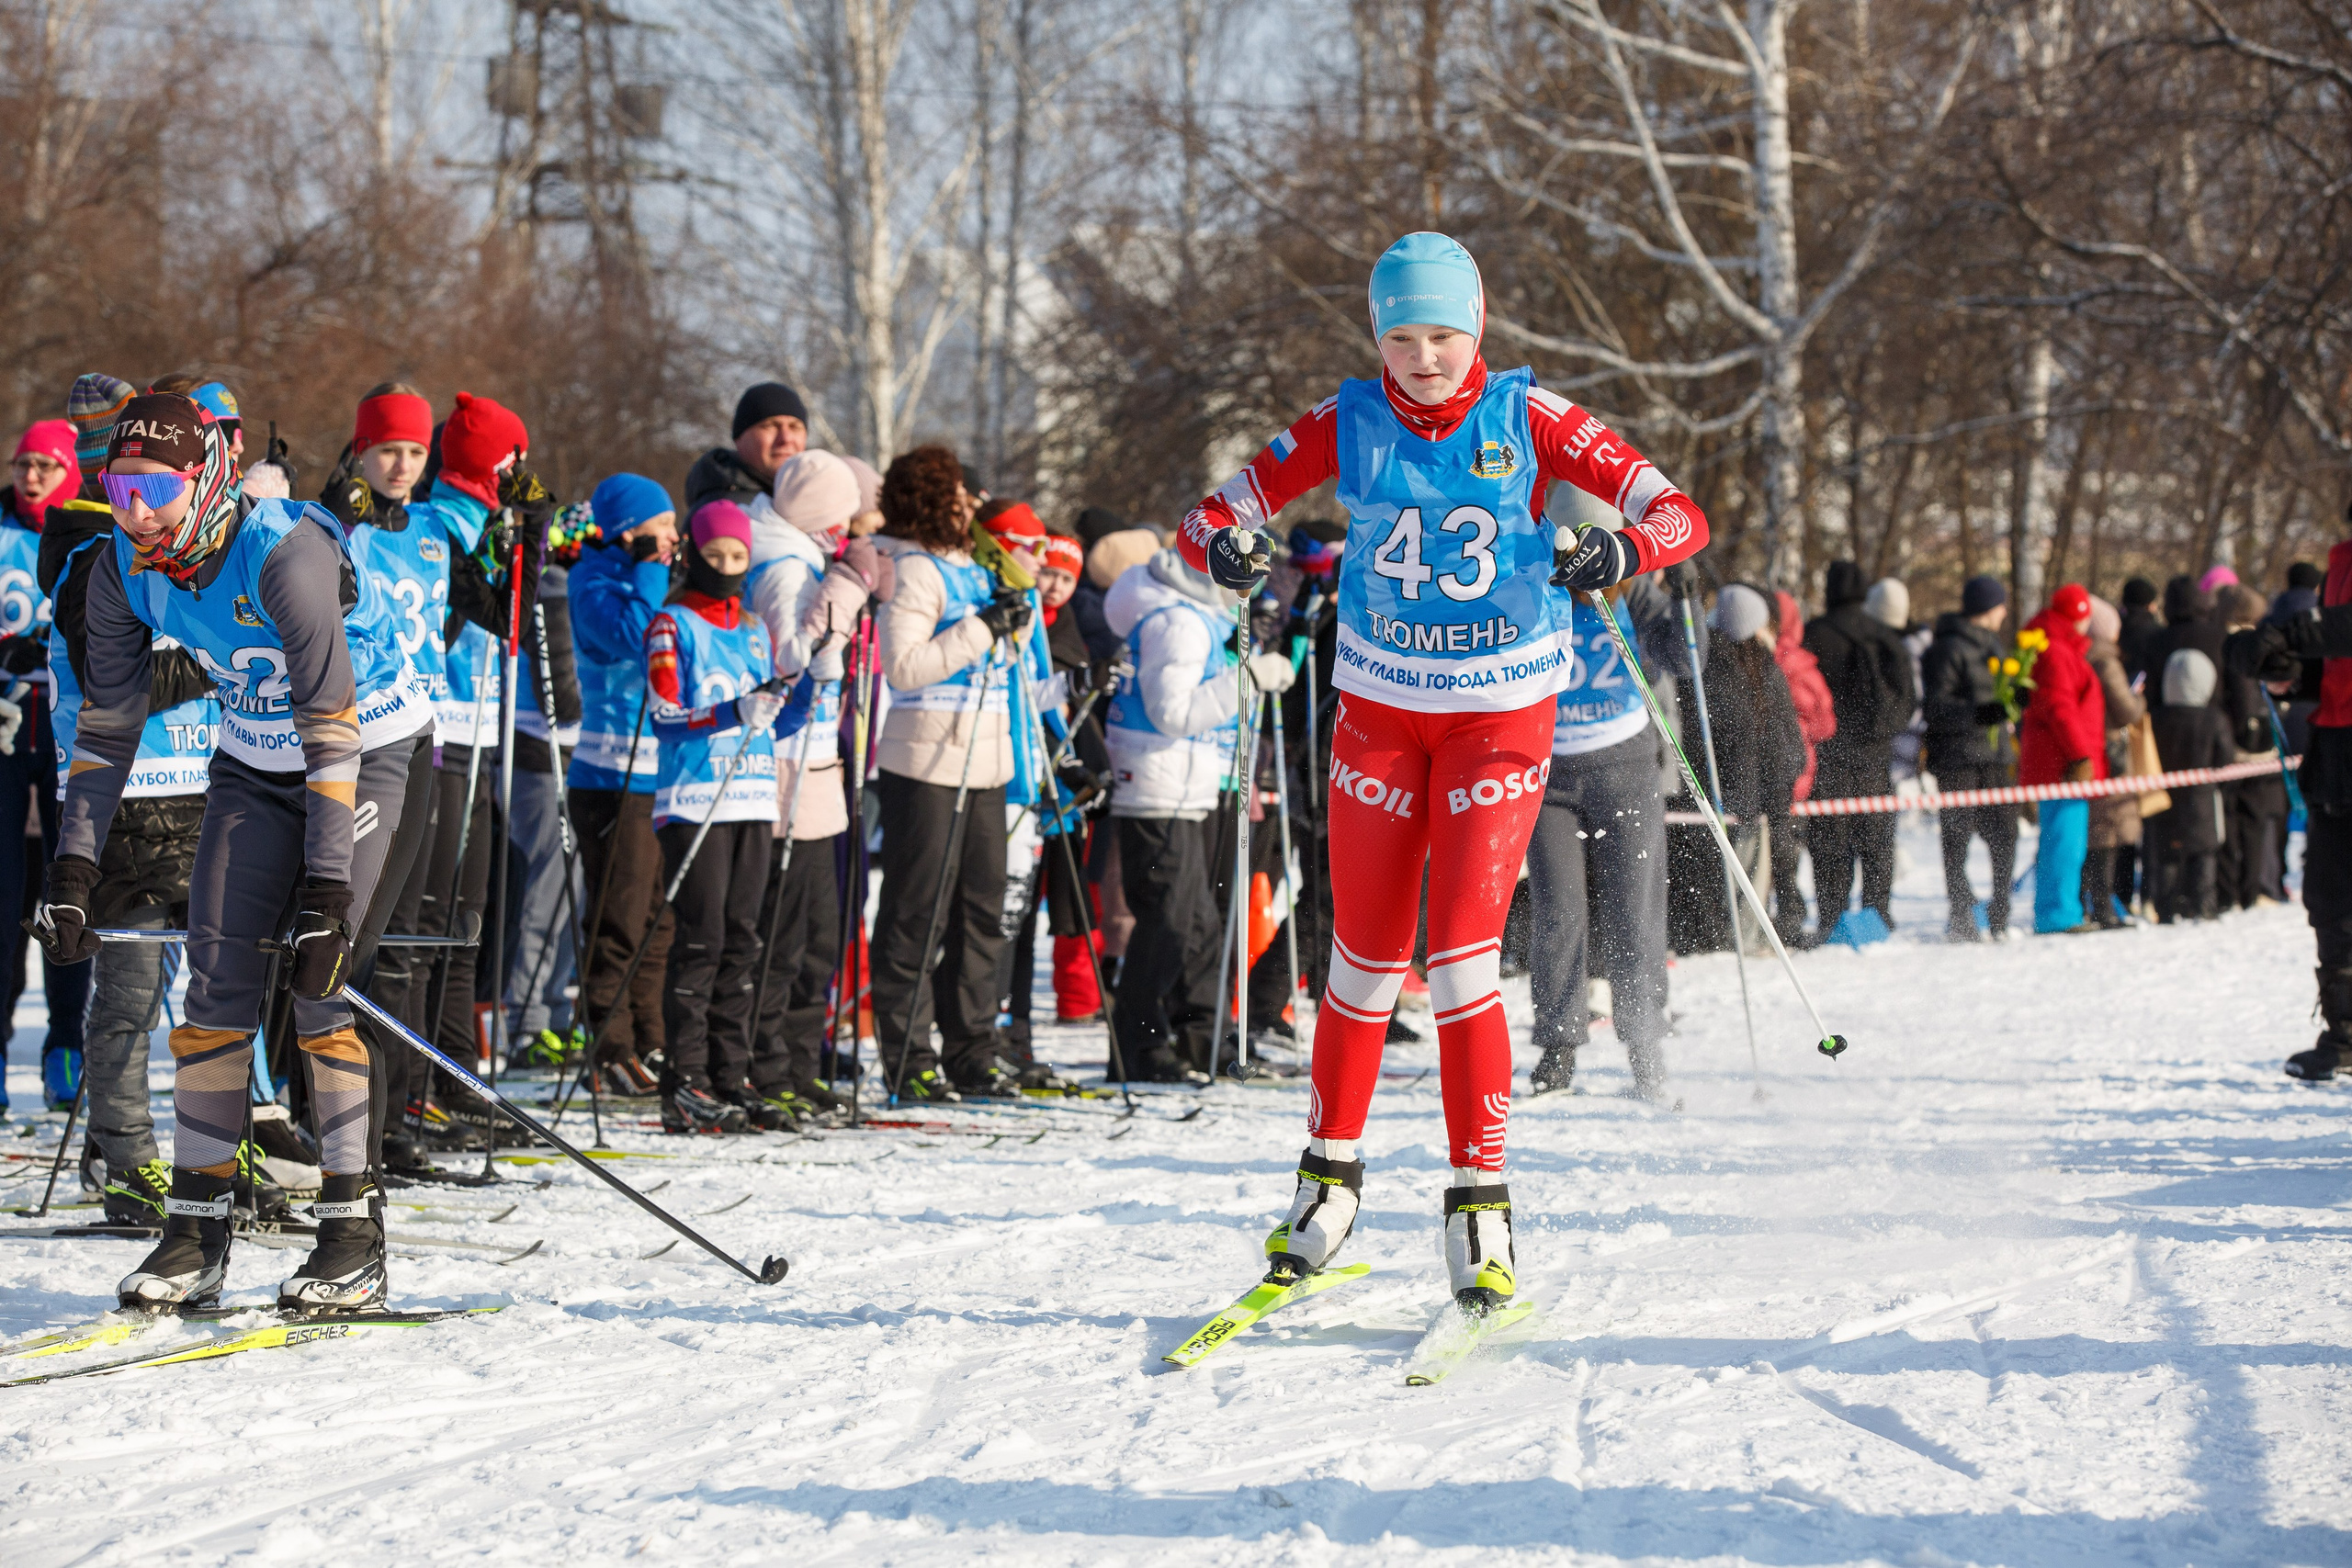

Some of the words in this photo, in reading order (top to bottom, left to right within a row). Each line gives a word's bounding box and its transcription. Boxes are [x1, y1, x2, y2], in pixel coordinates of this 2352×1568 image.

[1397, 294, 1444, 303] открытие
[1563, 415, 1607, 460] LUKO
[1220, 539, 1242, 567] MOAX
[1374, 504, 1499, 602] 43
[1565, 546, 1591, 575] MOAX
[1365, 607, 1520, 653] ТЮМЕНЬ
[1369, 660, 1420, 688] ГЛАВЫ
[1426, 671, 1498, 691] ГОРОДА
[1501, 648, 1567, 682] ТЮМЕНИ
[357, 695, 406, 725] МЕНИ
[1556, 700, 1624, 723] МЕНЬ
[165, 723, 220, 751] ТЮМ
[259, 731, 302, 750] ГОРО
[1343, 721, 1369, 744] RUSAL
[126, 771, 178, 787] КУБОК
[182, 770, 210, 784] ГЛАВ
[1329, 750, 1414, 818] UKOIL
[1447, 757, 1551, 816] BOSCO
[1296, 1168, 1343, 1187] FISCHER
[315, 1205, 353, 1214] salomon
[1456, 1201, 1511, 1213] FISCHER
[345, 1275, 370, 1297] salomon
[284, 1324, 350, 1348] FISCHER
